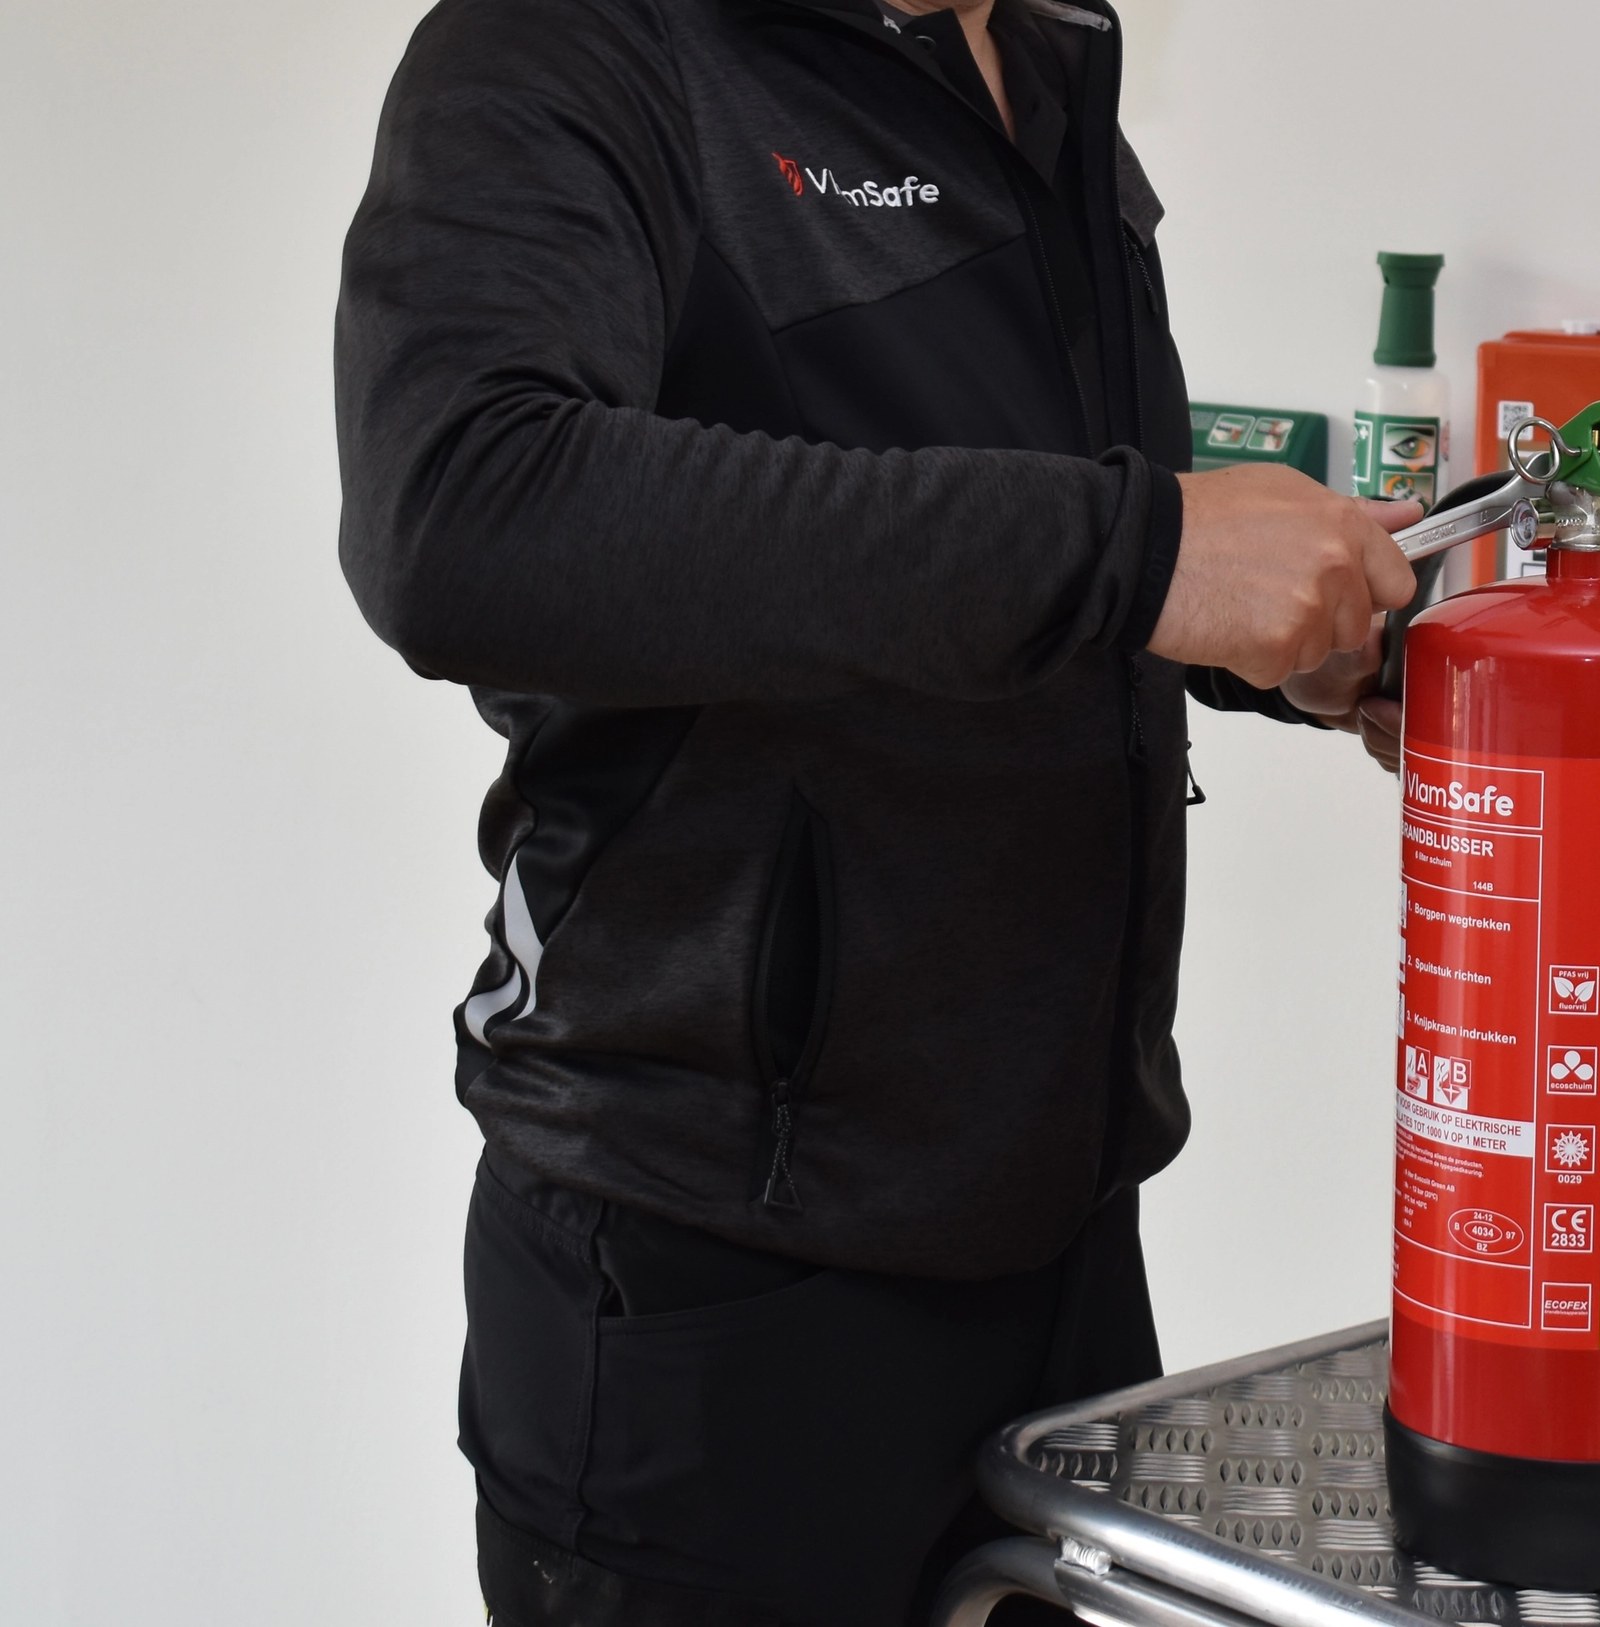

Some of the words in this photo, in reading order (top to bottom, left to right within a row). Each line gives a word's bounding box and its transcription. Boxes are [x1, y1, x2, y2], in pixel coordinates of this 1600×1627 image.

[1407, 769, 1514, 817] VlamSafe
[1402, 820, 1494, 858] RANDBLUSSER
[1473, 881, 1494, 892] 144B
[1407, 900, 1413, 912] 1.
[1414, 902, 1446, 922] Borgpen
[1448, 914, 1511, 932] wegtrekken
[1407, 954, 1413, 966] 2.
[1415, 958, 1452, 978] Spuitstuk
[1454, 969, 1492, 985] richten
[1559, 970, 1577, 978] PFAS
[1577, 971, 1589, 980] vrij
[1558, 1002, 1587, 1012] fluorvrij
[1413, 1012, 1457, 1036] Knijpkraan
[1459, 1026, 1517, 1045] indrukken
[1416, 1052, 1428, 1075] A
[1453, 1061, 1467, 1084] B
[1550, 1081, 1593, 1091] ecoschuim
[1412, 1103, 1440, 1123] GEBRUIK
[1441, 1113, 1453, 1125] OP
[1454, 1116, 1522, 1137] ELEKTRISCHE
[1413, 1119, 1425, 1133] TOT
[1426, 1124, 1442, 1138] 1000
[1443, 1129, 1450, 1140] V
[1451, 1131, 1464, 1143] OP
[1465, 1135, 1470, 1145] 1
[1472, 1135, 1507, 1151] METER
[1557, 1174, 1583, 1185] 0029
[1473, 1211, 1493, 1222] 24-12
[1551, 1209, 1587, 1233] CE
[1471, 1226, 1494, 1238] 4034
[1505, 1231, 1516, 1240] 97
[1551, 1233, 1586, 1247] 2833
[1544, 1299, 1588, 1311] ECOFEX
